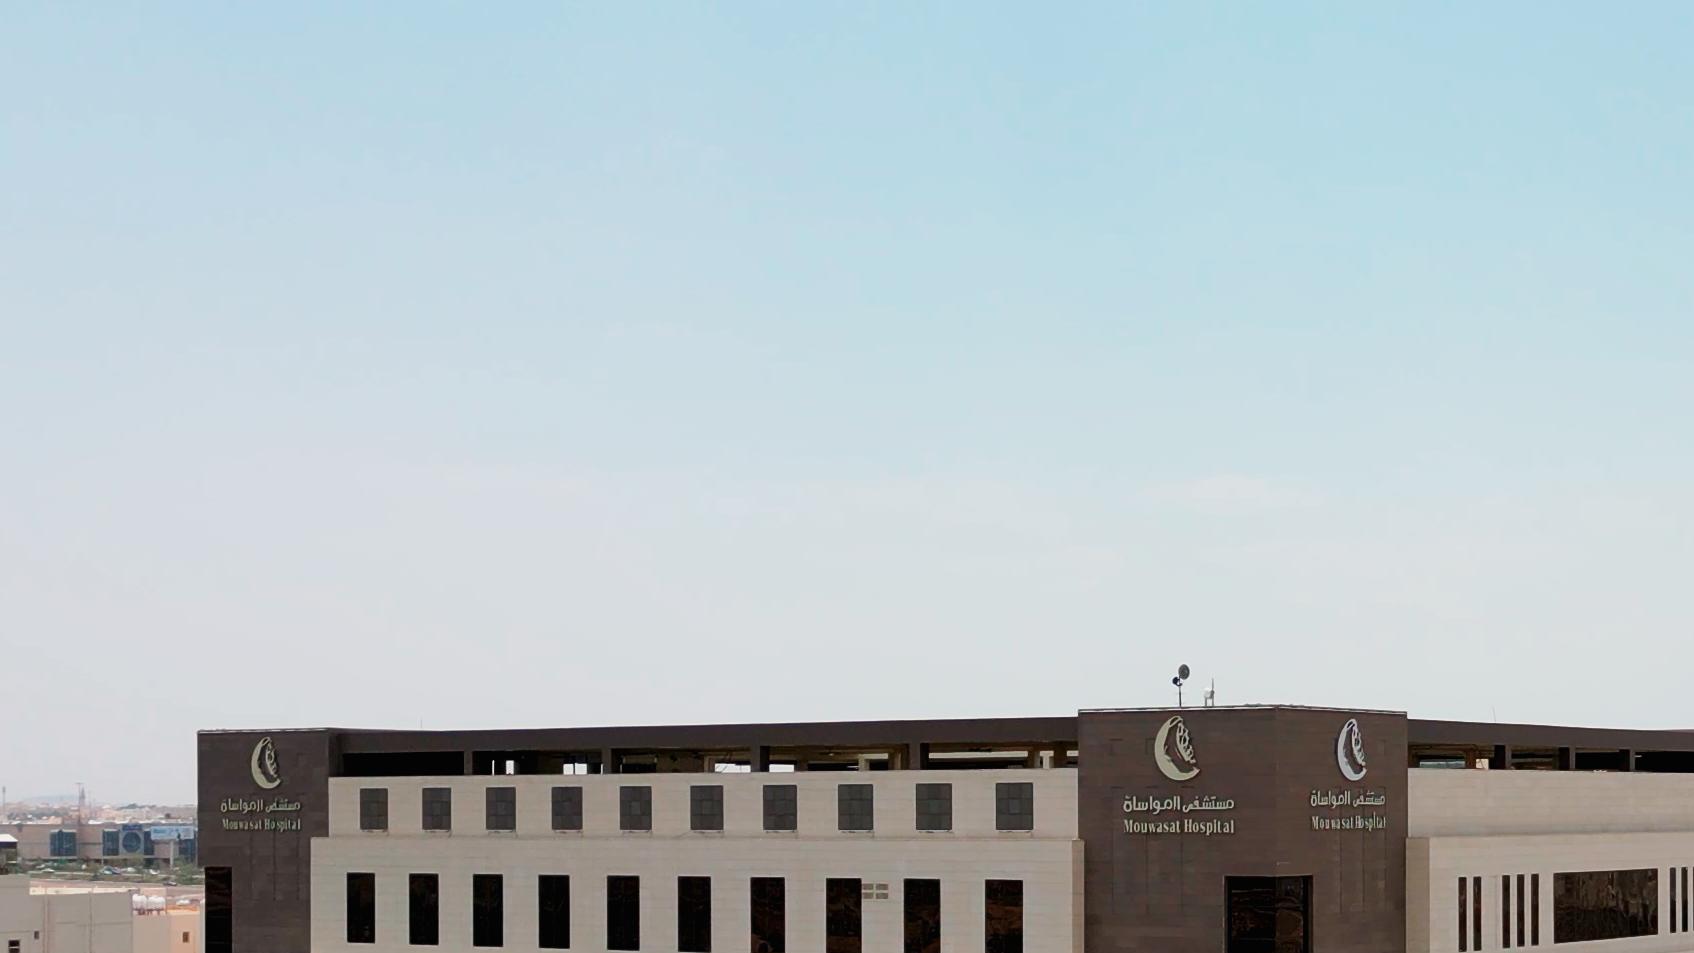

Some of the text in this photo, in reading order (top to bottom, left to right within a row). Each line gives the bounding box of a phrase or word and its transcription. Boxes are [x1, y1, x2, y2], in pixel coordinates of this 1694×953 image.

[1123, 795, 1235, 815] مستشفى المواساة
[1123, 819, 1235, 836] Mouwasat Hospital
